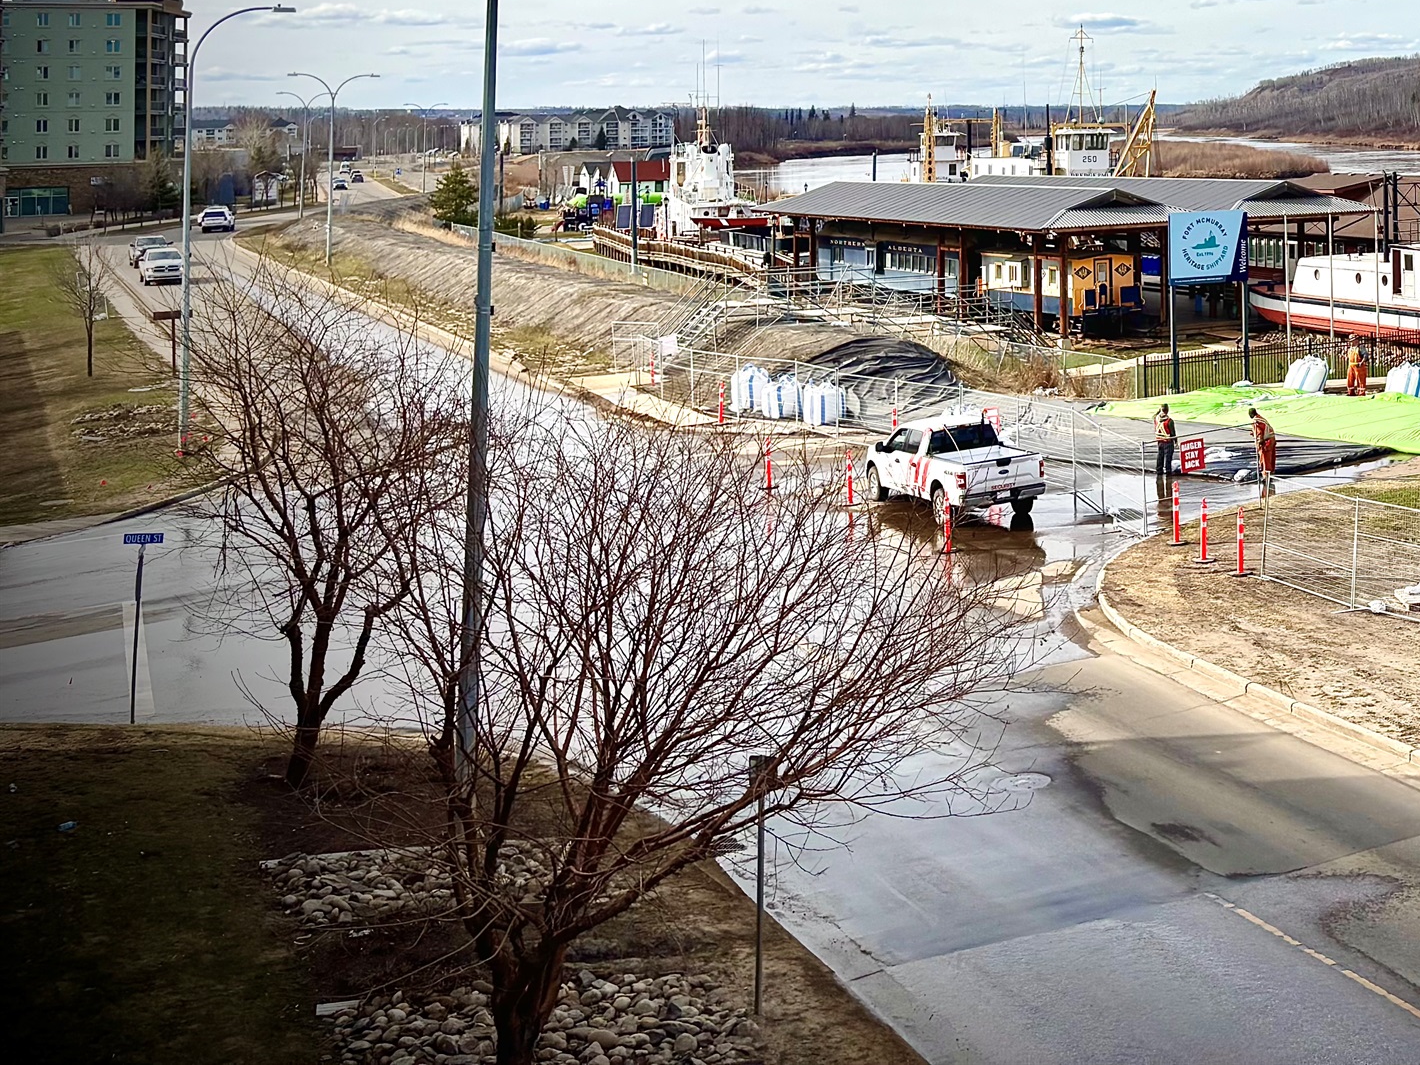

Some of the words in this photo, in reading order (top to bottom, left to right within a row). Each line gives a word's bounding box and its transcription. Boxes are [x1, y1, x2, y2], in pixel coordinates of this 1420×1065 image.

[1082, 155, 1098, 163] 250
[1182, 222, 1195, 240] FORT
[1182, 248, 1205, 271] HERITAGE
[1205, 245, 1229, 271] SHIPYARD
[1239, 239, 1247, 274] Welcome
[1185, 450, 1199, 460] STAY
[125, 534, 151, 544] QUEEN
[153, 534, 162, 543] ST
